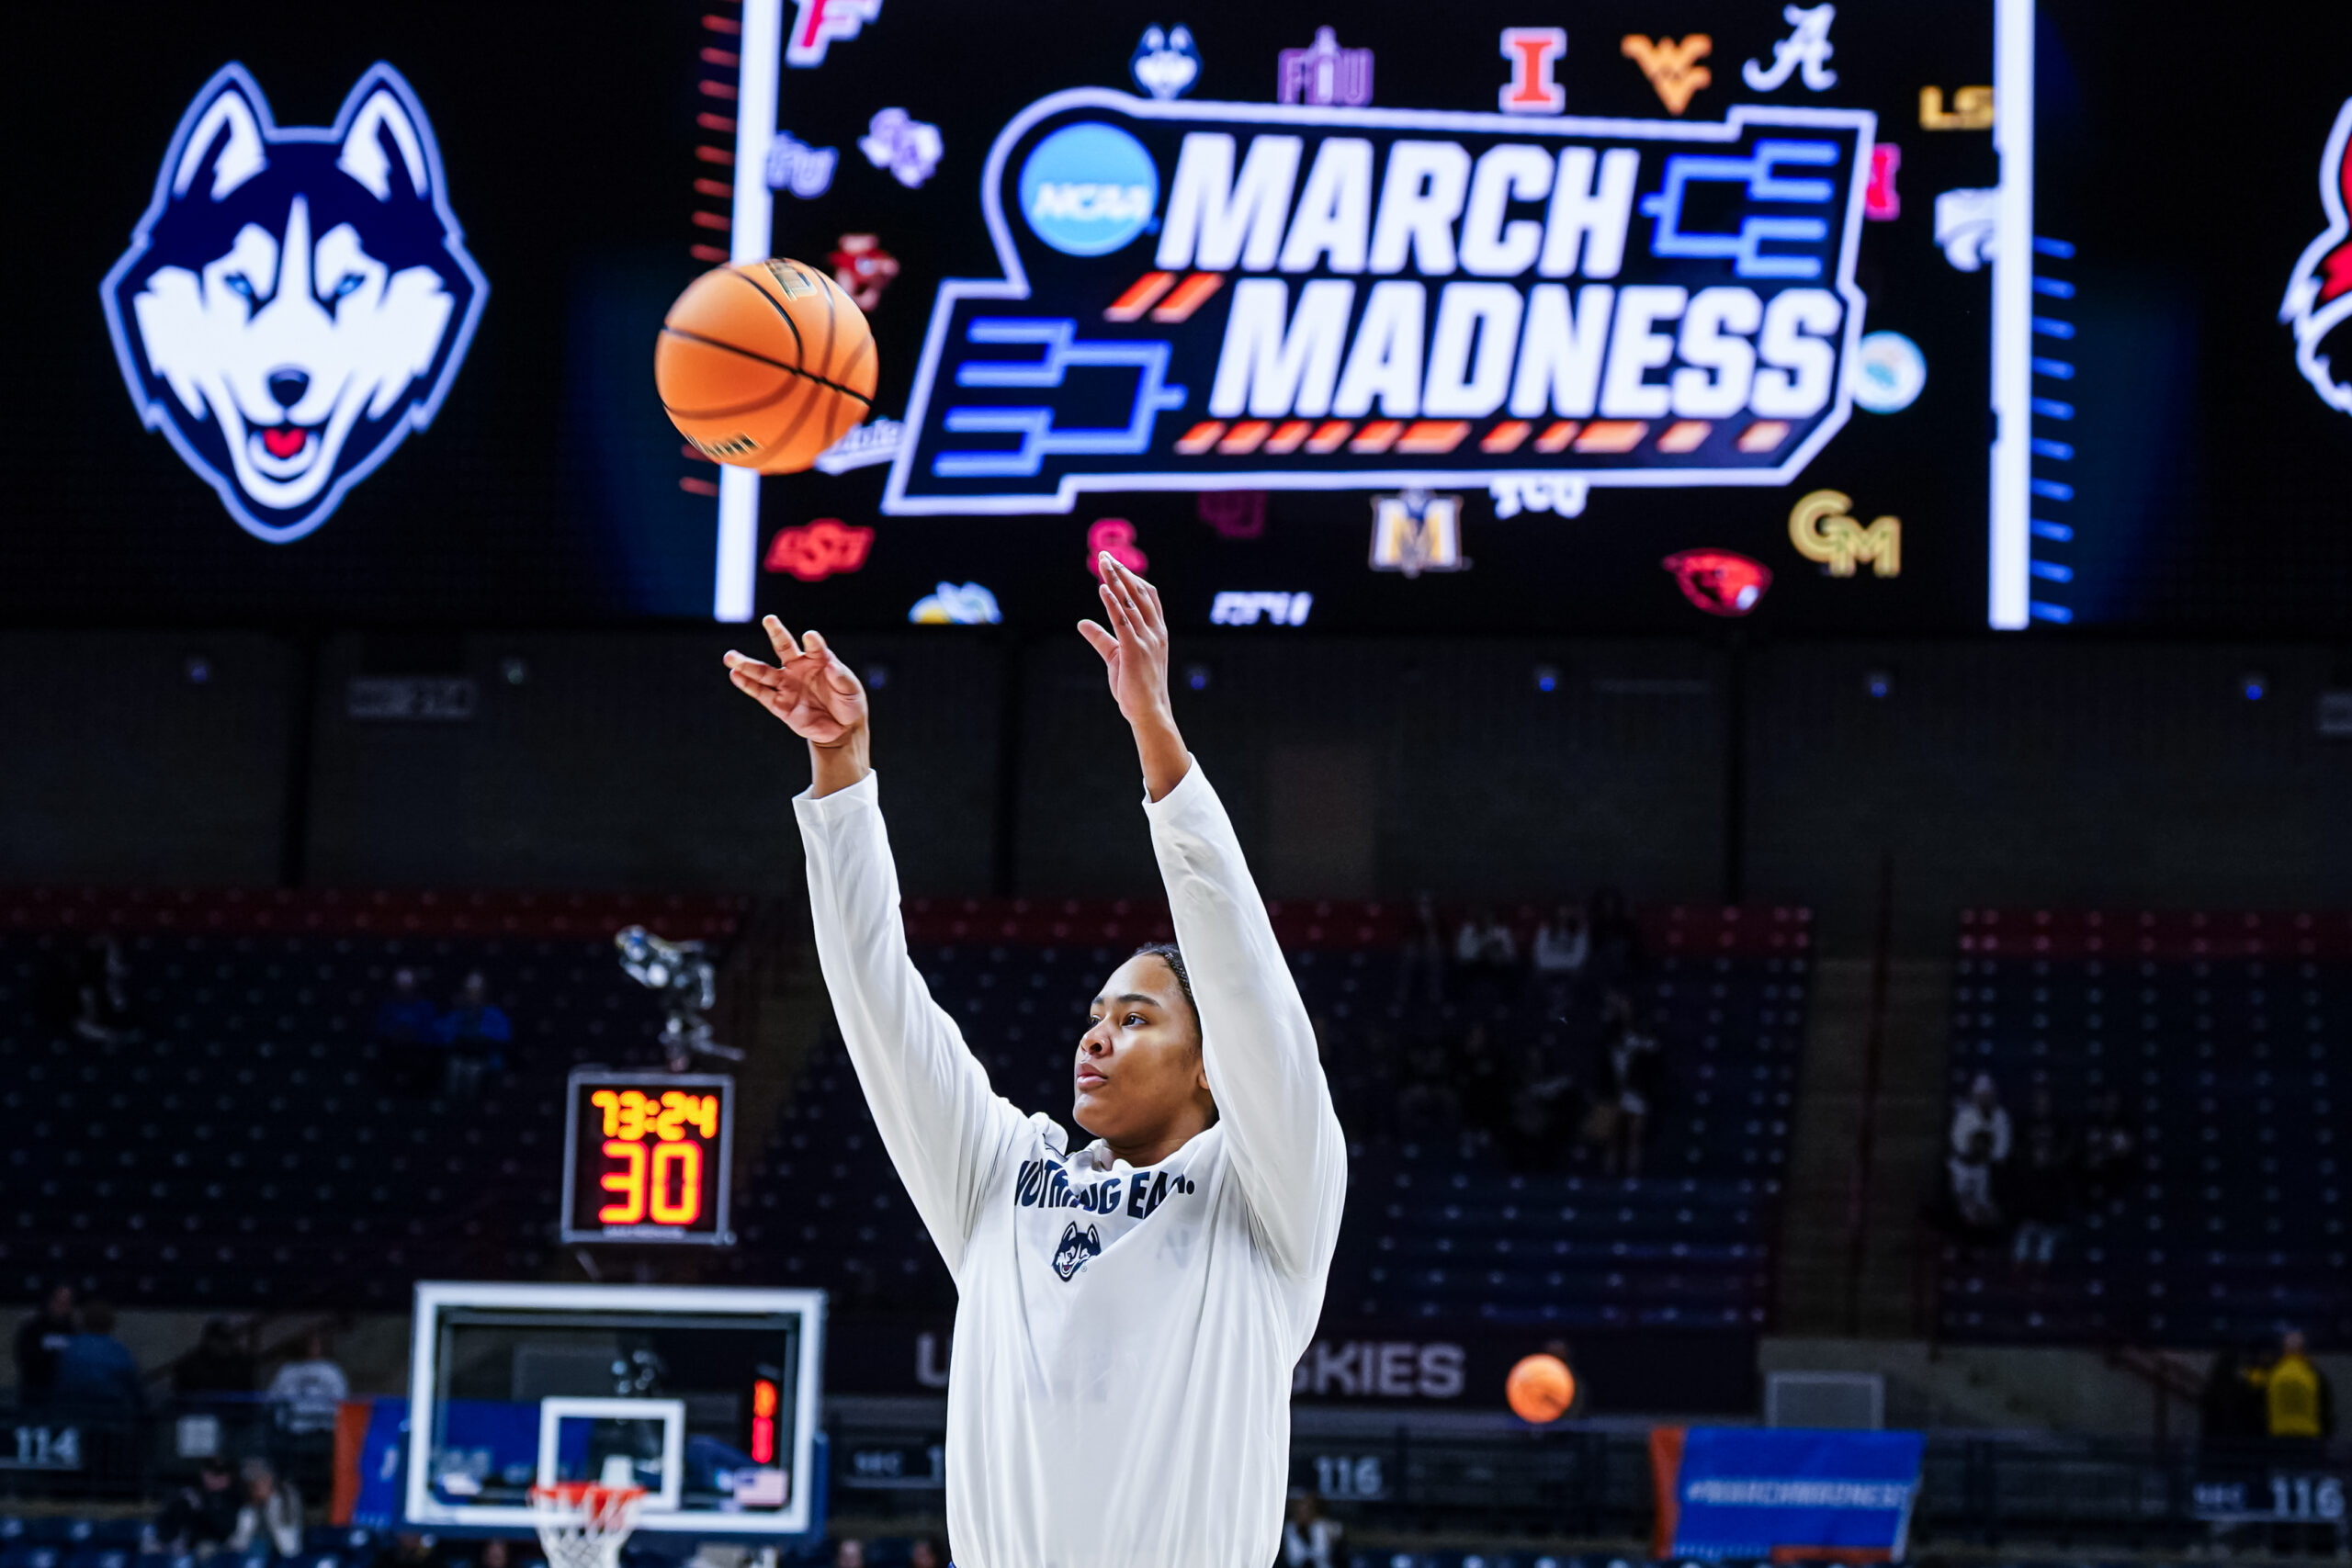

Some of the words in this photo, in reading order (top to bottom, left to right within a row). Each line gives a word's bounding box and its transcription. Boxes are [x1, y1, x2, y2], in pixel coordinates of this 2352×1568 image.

[1032, 182, 1152, 221] NCAA
[1155, 133, 1639, 277] MARCH
[1209, 278, 1842, 418] MADNESS
[598, 1139, 703, 1225] 30
[15, 1426, 80, 1465] 114
[1316, 1456, 1382, 1495] 116
[2271, 1476, 2345, 1519] 116
